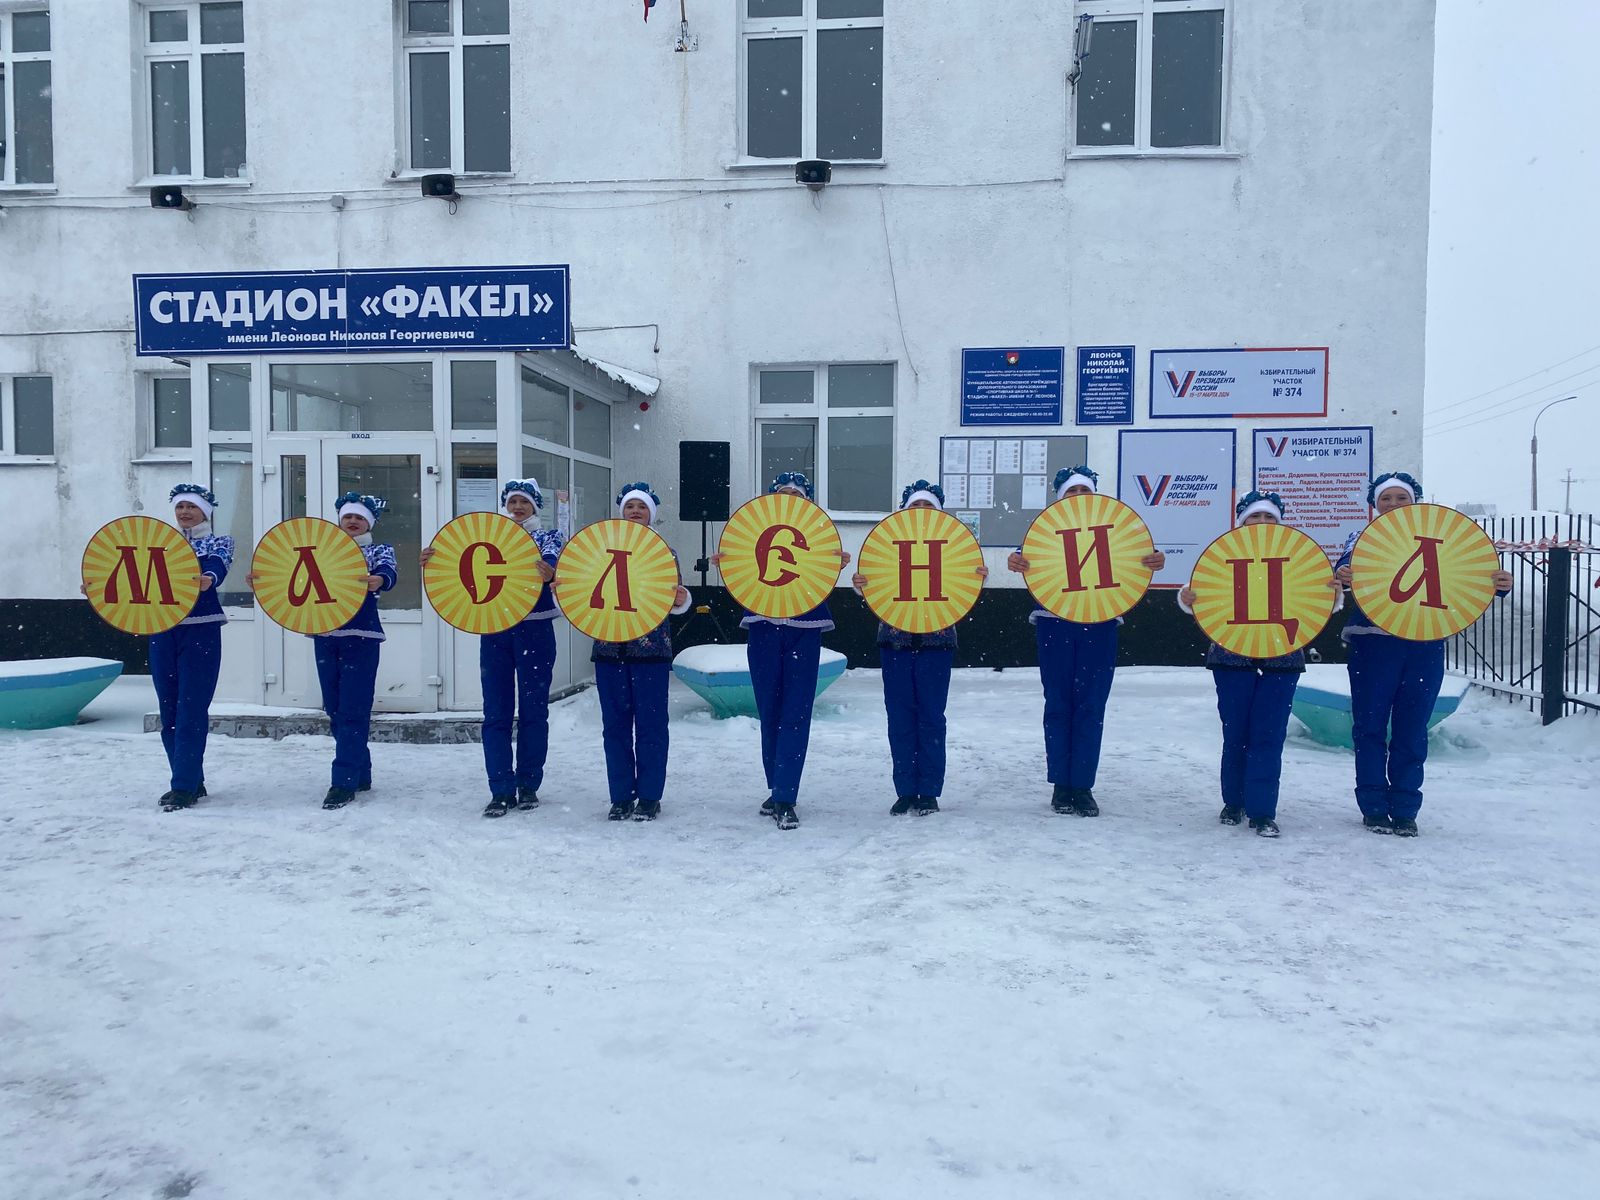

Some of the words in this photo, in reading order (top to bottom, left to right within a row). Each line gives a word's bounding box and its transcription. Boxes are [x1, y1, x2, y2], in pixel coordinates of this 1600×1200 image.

[150, 288, 346, 328] СТАДИОН
[360, 284, 554, 318] «ФАКЕЛ»
[227, 334, 268, 344] имени
[270, 331, 326, 342] Леонова
[330, 330, 386, 341] Николая
[390, 329, 474, 342] Георгиевича
[1260, 368, 1316, 376] ИЗБИРАТЕЛЬНЫЙ
[1285, 387, 1302, 396] 374
[1292, 436, 1362, 445] ИЗБИРАТЕЛЬНЫЙ
